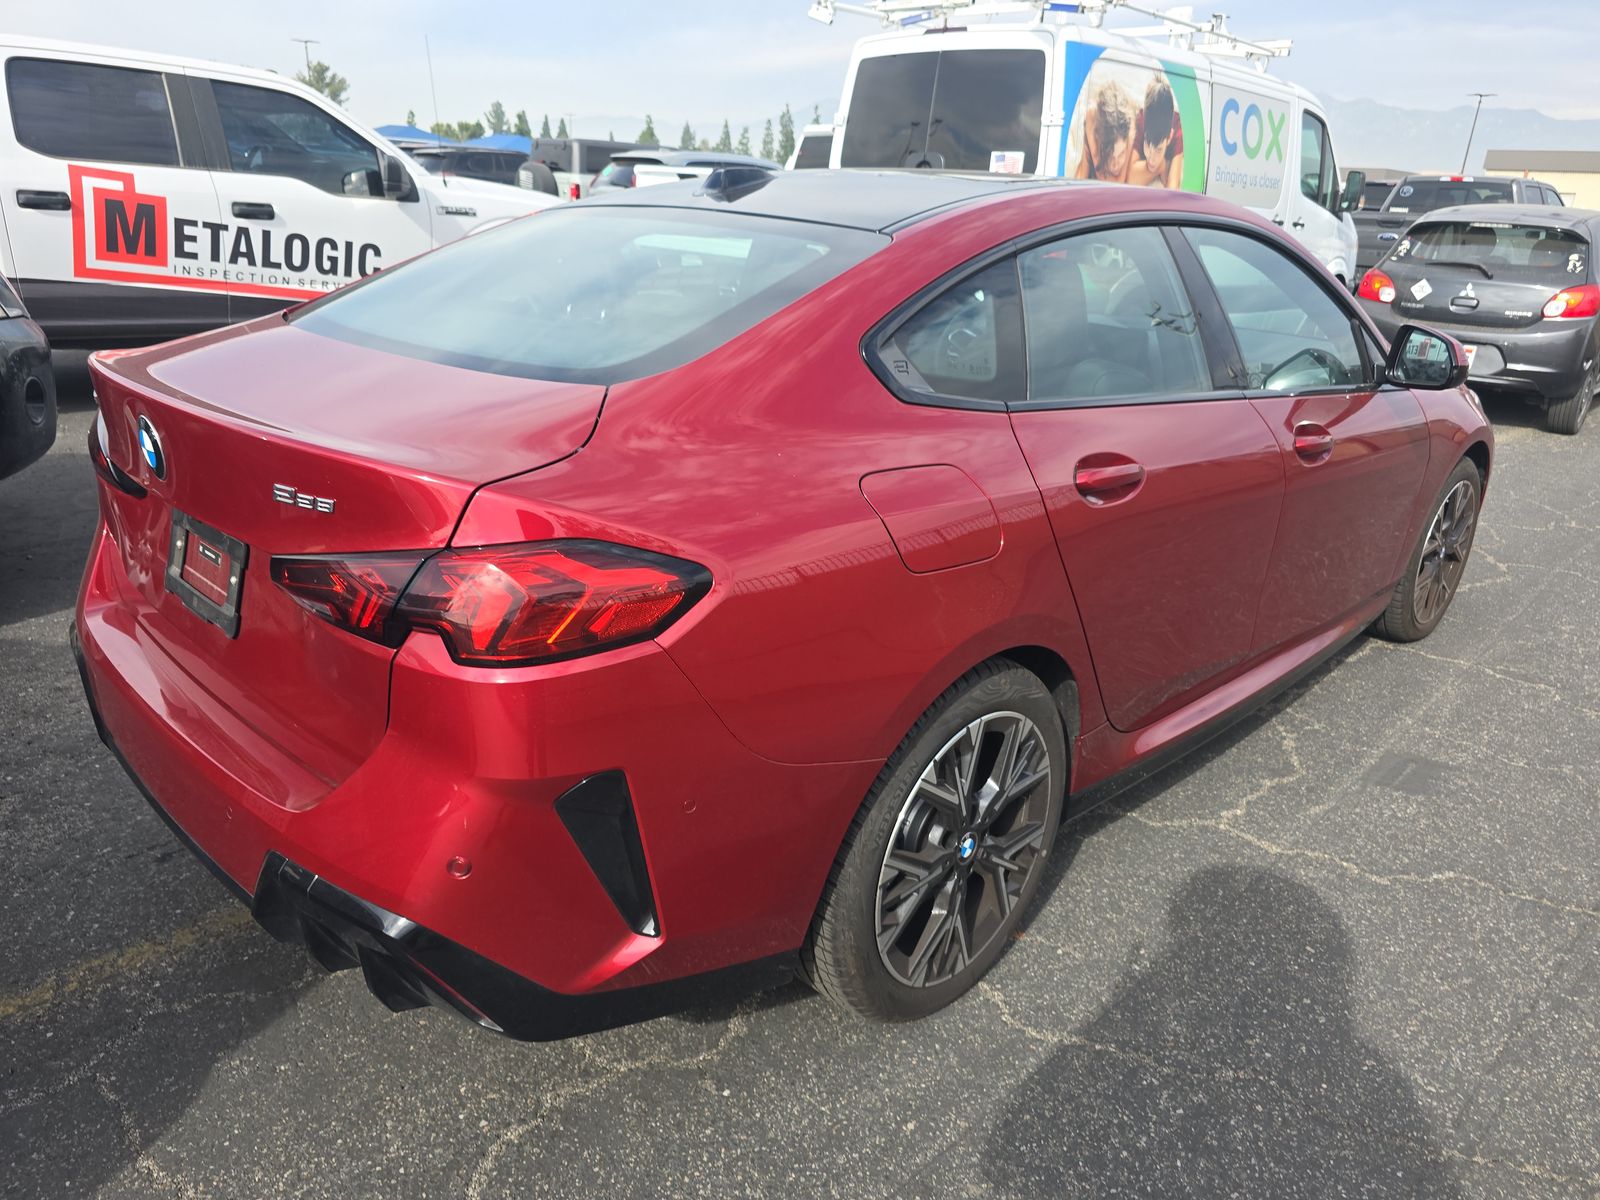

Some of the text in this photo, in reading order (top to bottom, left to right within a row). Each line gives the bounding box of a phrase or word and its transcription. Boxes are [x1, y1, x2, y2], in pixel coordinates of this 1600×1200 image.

[1220, 98, 1286, 163] COX
[1215, 166, 1281, 189] Bringing us closer
[104, 198, 382, 279] METALOGIC
[173, 264, 349, 290] INSPECTION SERV
